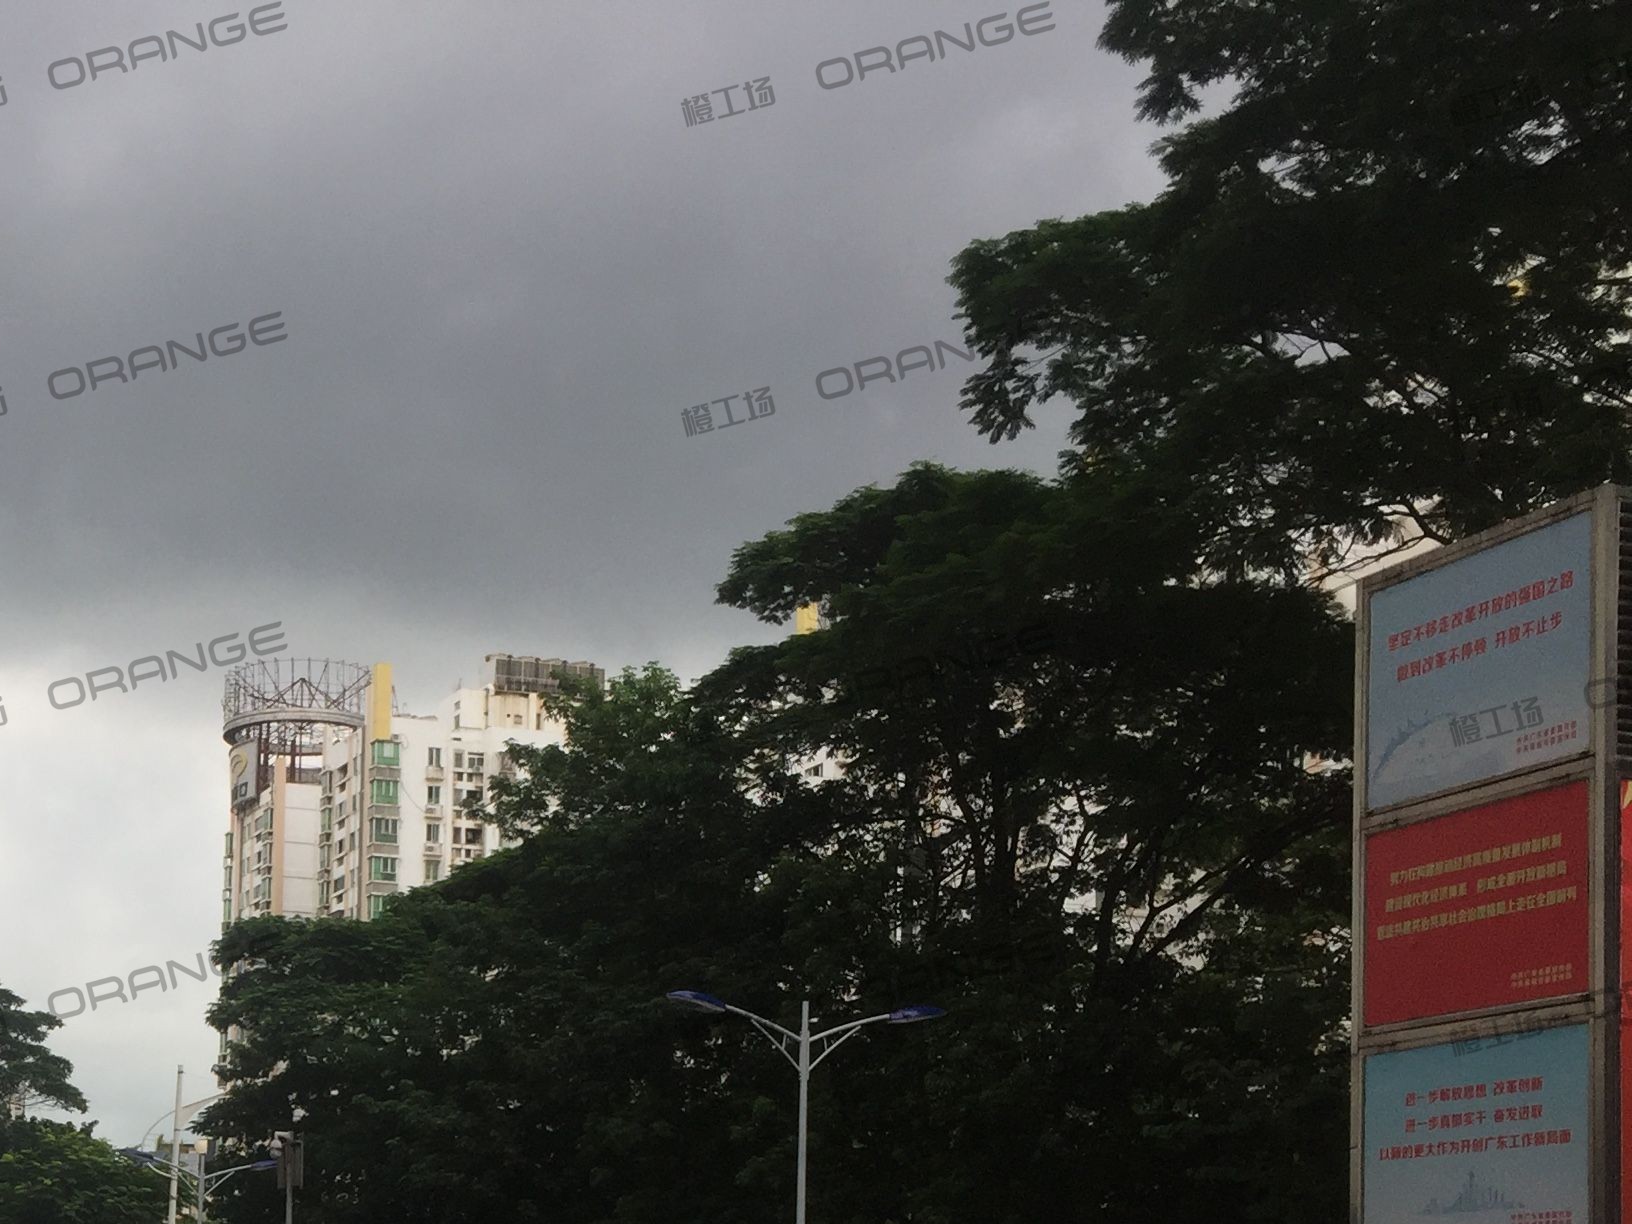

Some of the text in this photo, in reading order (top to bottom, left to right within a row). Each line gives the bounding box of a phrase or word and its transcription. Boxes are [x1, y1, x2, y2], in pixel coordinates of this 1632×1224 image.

[1494, 611, 1563, 649] 开放不止步
